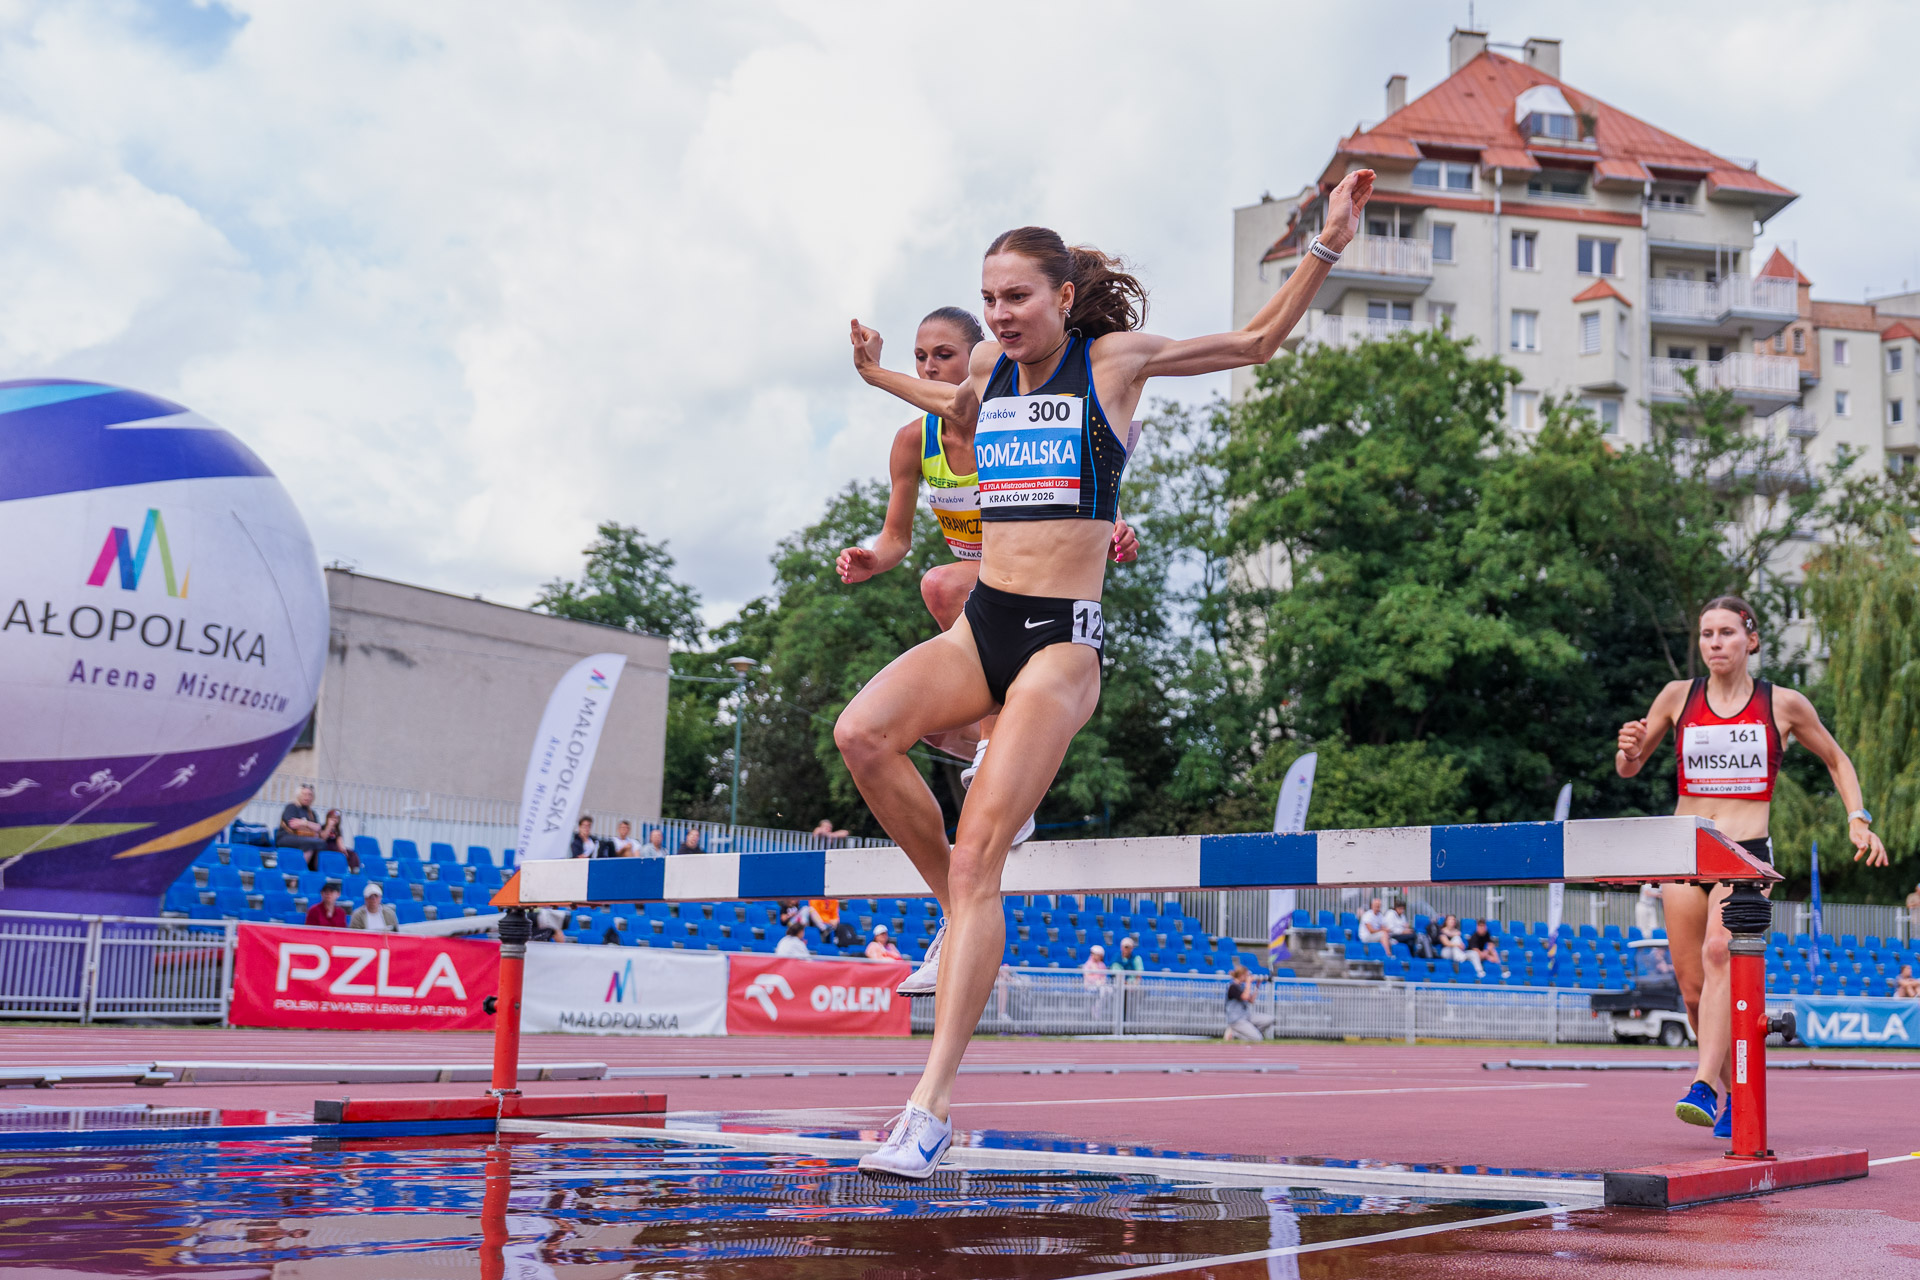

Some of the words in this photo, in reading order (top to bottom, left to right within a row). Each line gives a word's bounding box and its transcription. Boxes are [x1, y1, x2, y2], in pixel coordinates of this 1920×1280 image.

[985, 408, 1016, 420] Kraków
[1028, 401, 1071, 422] 300
[975, 435, 1077, 469] DOMŻALSKA
[1001, 481, 1035, 490] Mistrzostwa
[1036, 480, 1054, 488] Polski
[937, 496, 964, 504] Kraków
[989, 492, 1030, 504] KRAKÓW
[1031, 492, 1055, 502] 2026
[938, 515, 983, 535] KRAWCZ
[1075, 607, 1103, 641] 12
[68, 658, 157, 691] Arena
[176, 671, 291, 714] Mistrzostw
[1729, 729, 1759, 743] 161
[540, 735, 561, 776] Arena
[541, 696, 598, 835] MAŁOPOLSKA
[1687, 754, 1762, 770] MISSALA
[275, 942, 468, 1001] PZLA
[273, 999, 319, 1011] POLSKI
[810, 984, 891, 1014] ORLEN
[559, 1010, 680, 1031] MAŁOPOLSKA
[1807, 1010, 1910, 1040] MZLA
